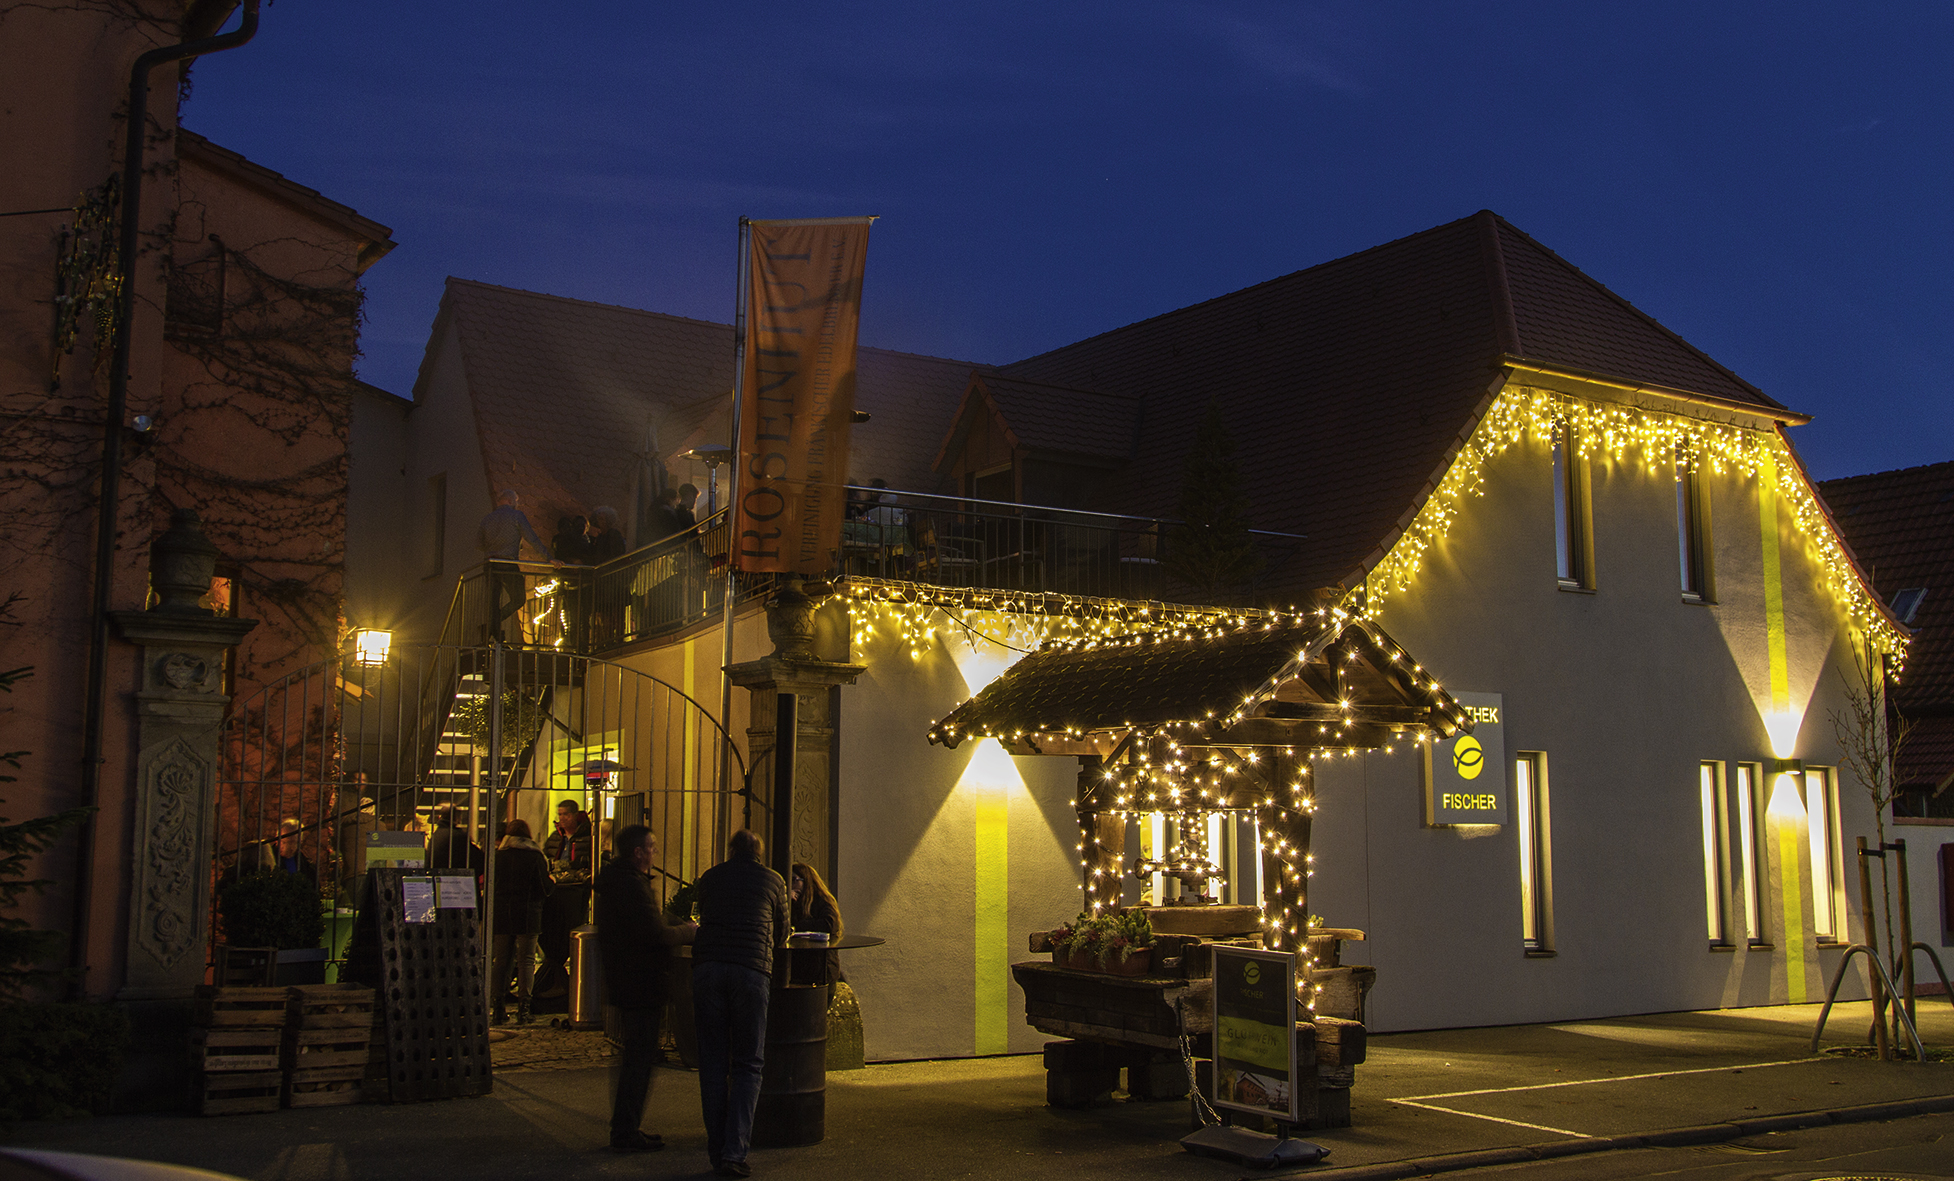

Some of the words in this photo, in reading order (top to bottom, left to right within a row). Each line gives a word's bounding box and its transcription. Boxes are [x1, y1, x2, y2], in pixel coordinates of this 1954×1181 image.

[740, 240, 812, 562] ROSENHUT
[806, 368, 831, 465] FRÄNKISCHER
[800, 469, 822, 562] VEREINIGUNG
[1442, 793, 1497, 810] FISCHER
